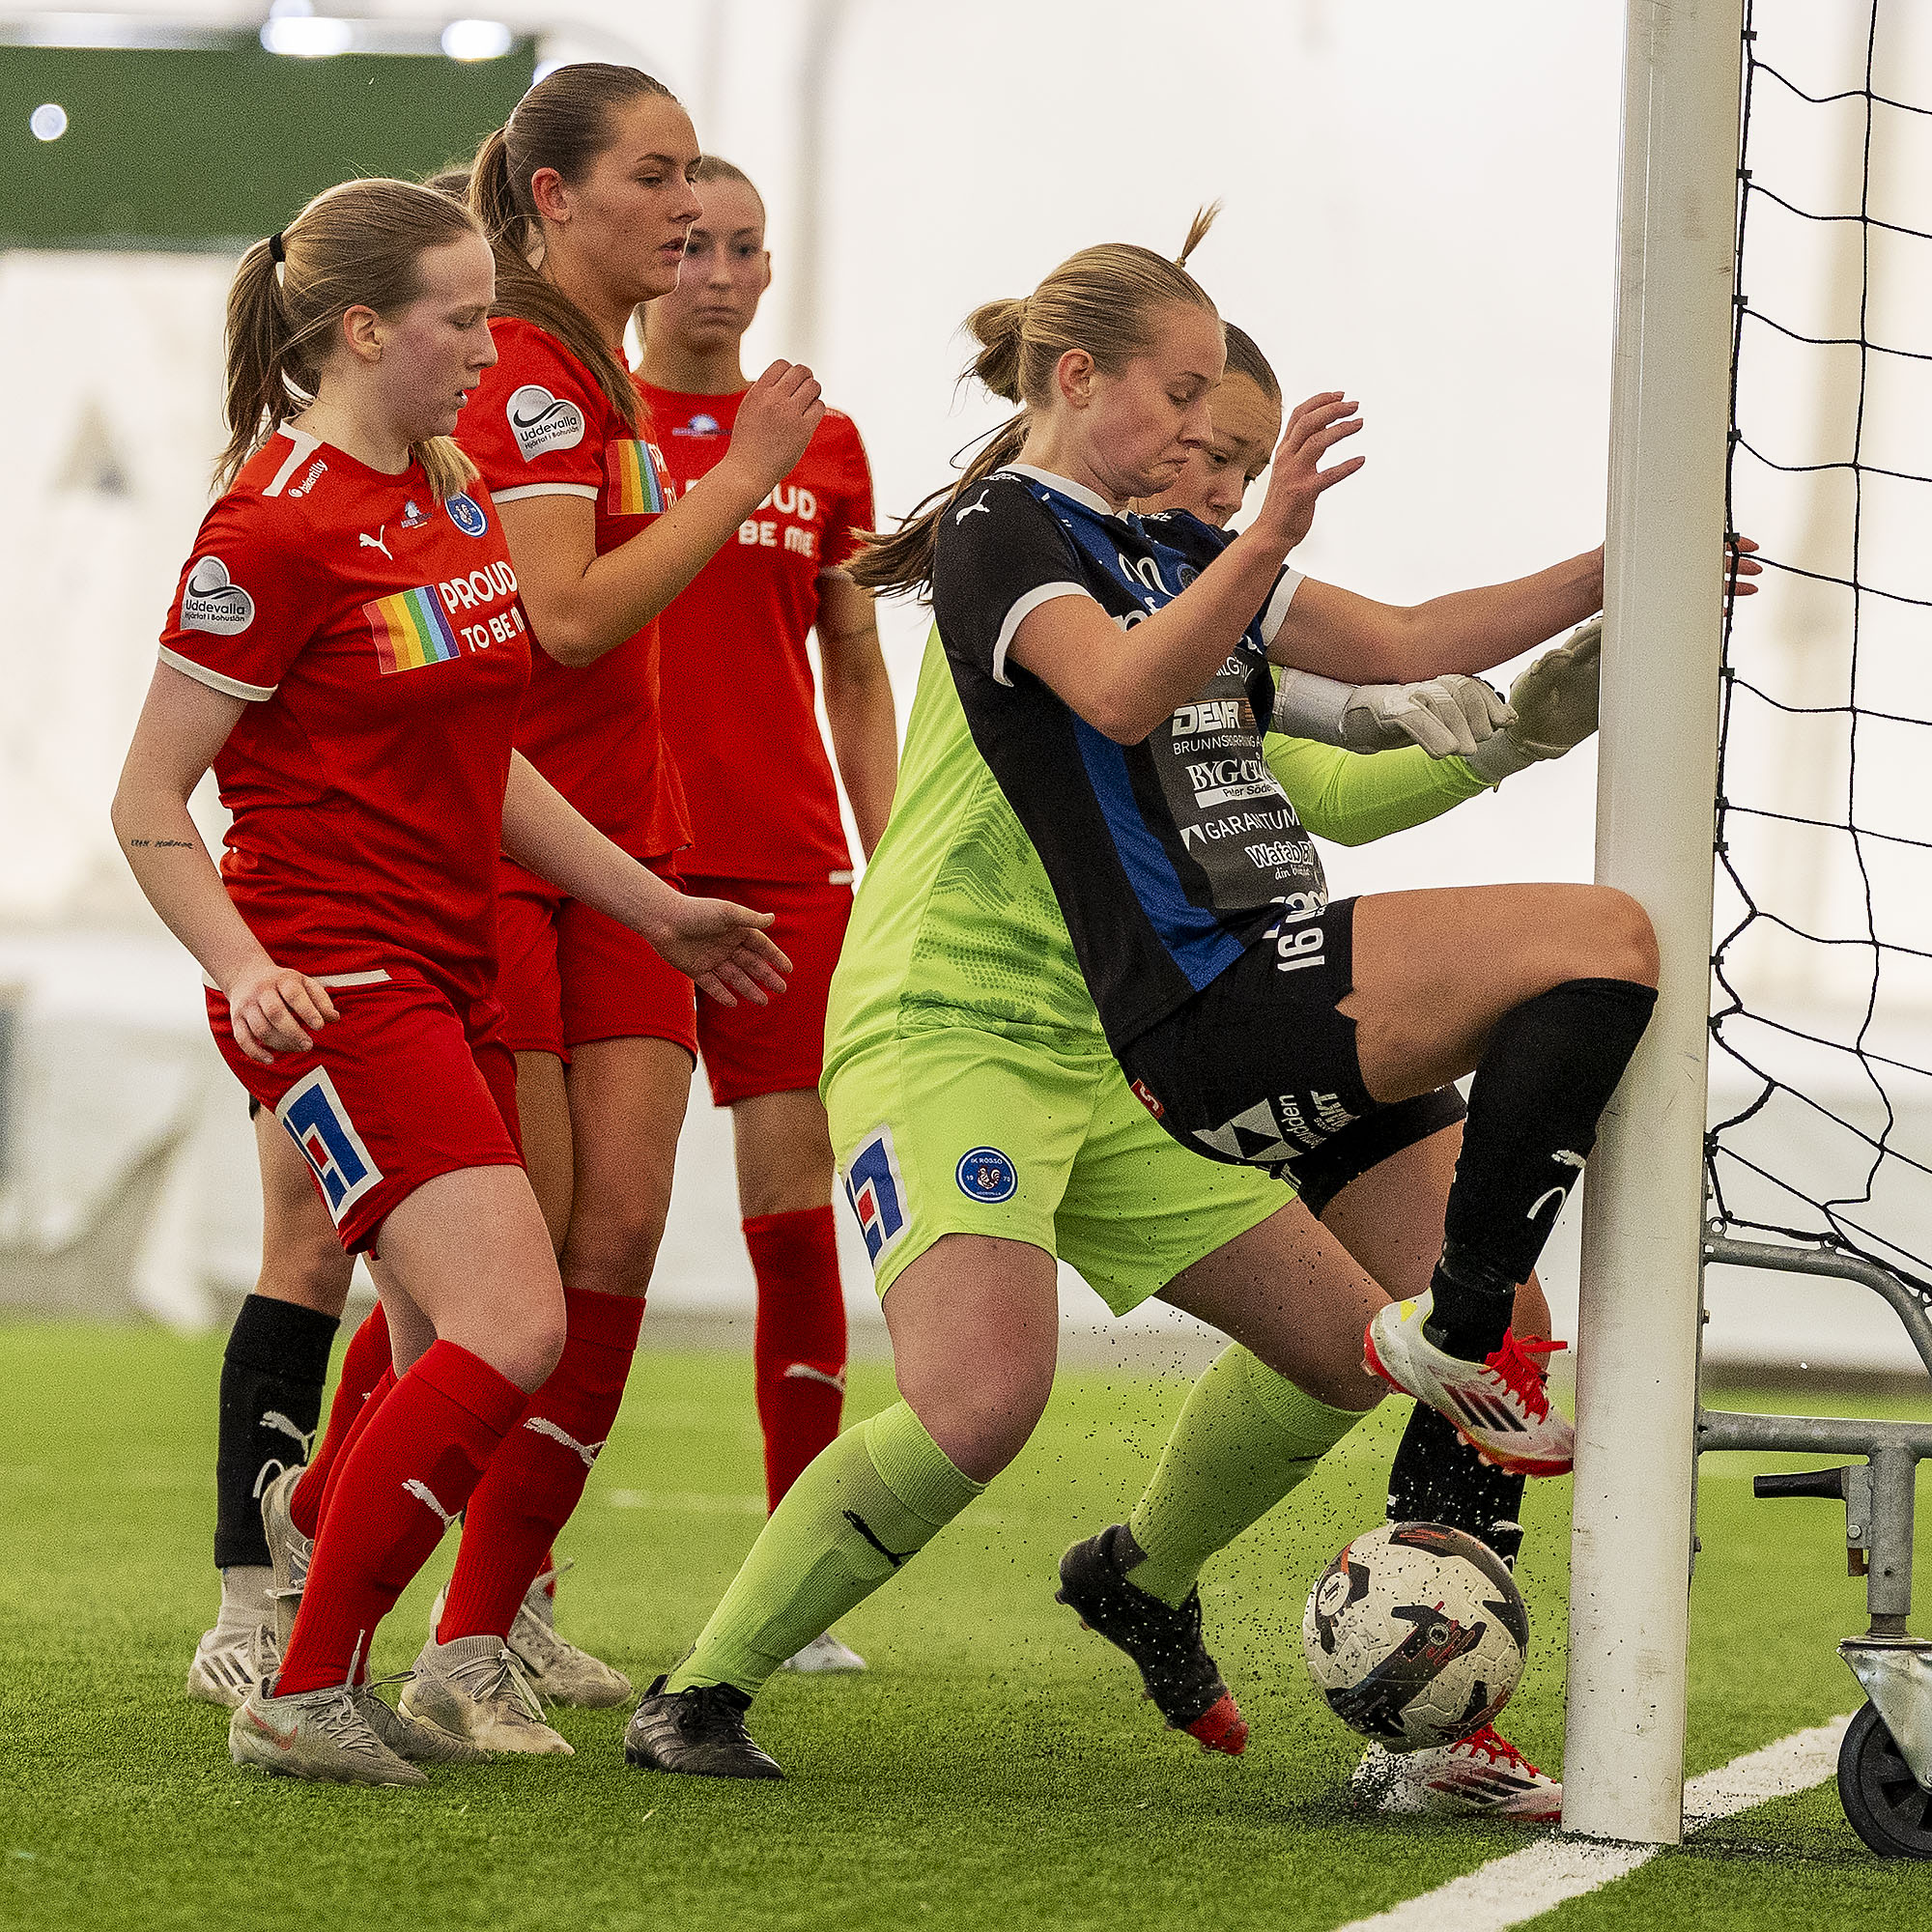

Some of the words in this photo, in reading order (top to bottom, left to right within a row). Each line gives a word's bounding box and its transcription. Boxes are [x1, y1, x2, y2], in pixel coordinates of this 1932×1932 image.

[520, 416, 577, 441] Uddevalla
[738, 519, 779, 548] BE
[439, 560, 518, 614] PROUD
[185, 599, 245, 615] Uddevalla
[460, 624, 490, 652] TO
[488, 612, 517, 643] BE
[1205, 809, 1301, 840] GARANTUM
[1244, 840, 1301, 868] Wafab
[979, 1156, 1003, 1165] ROSSO
